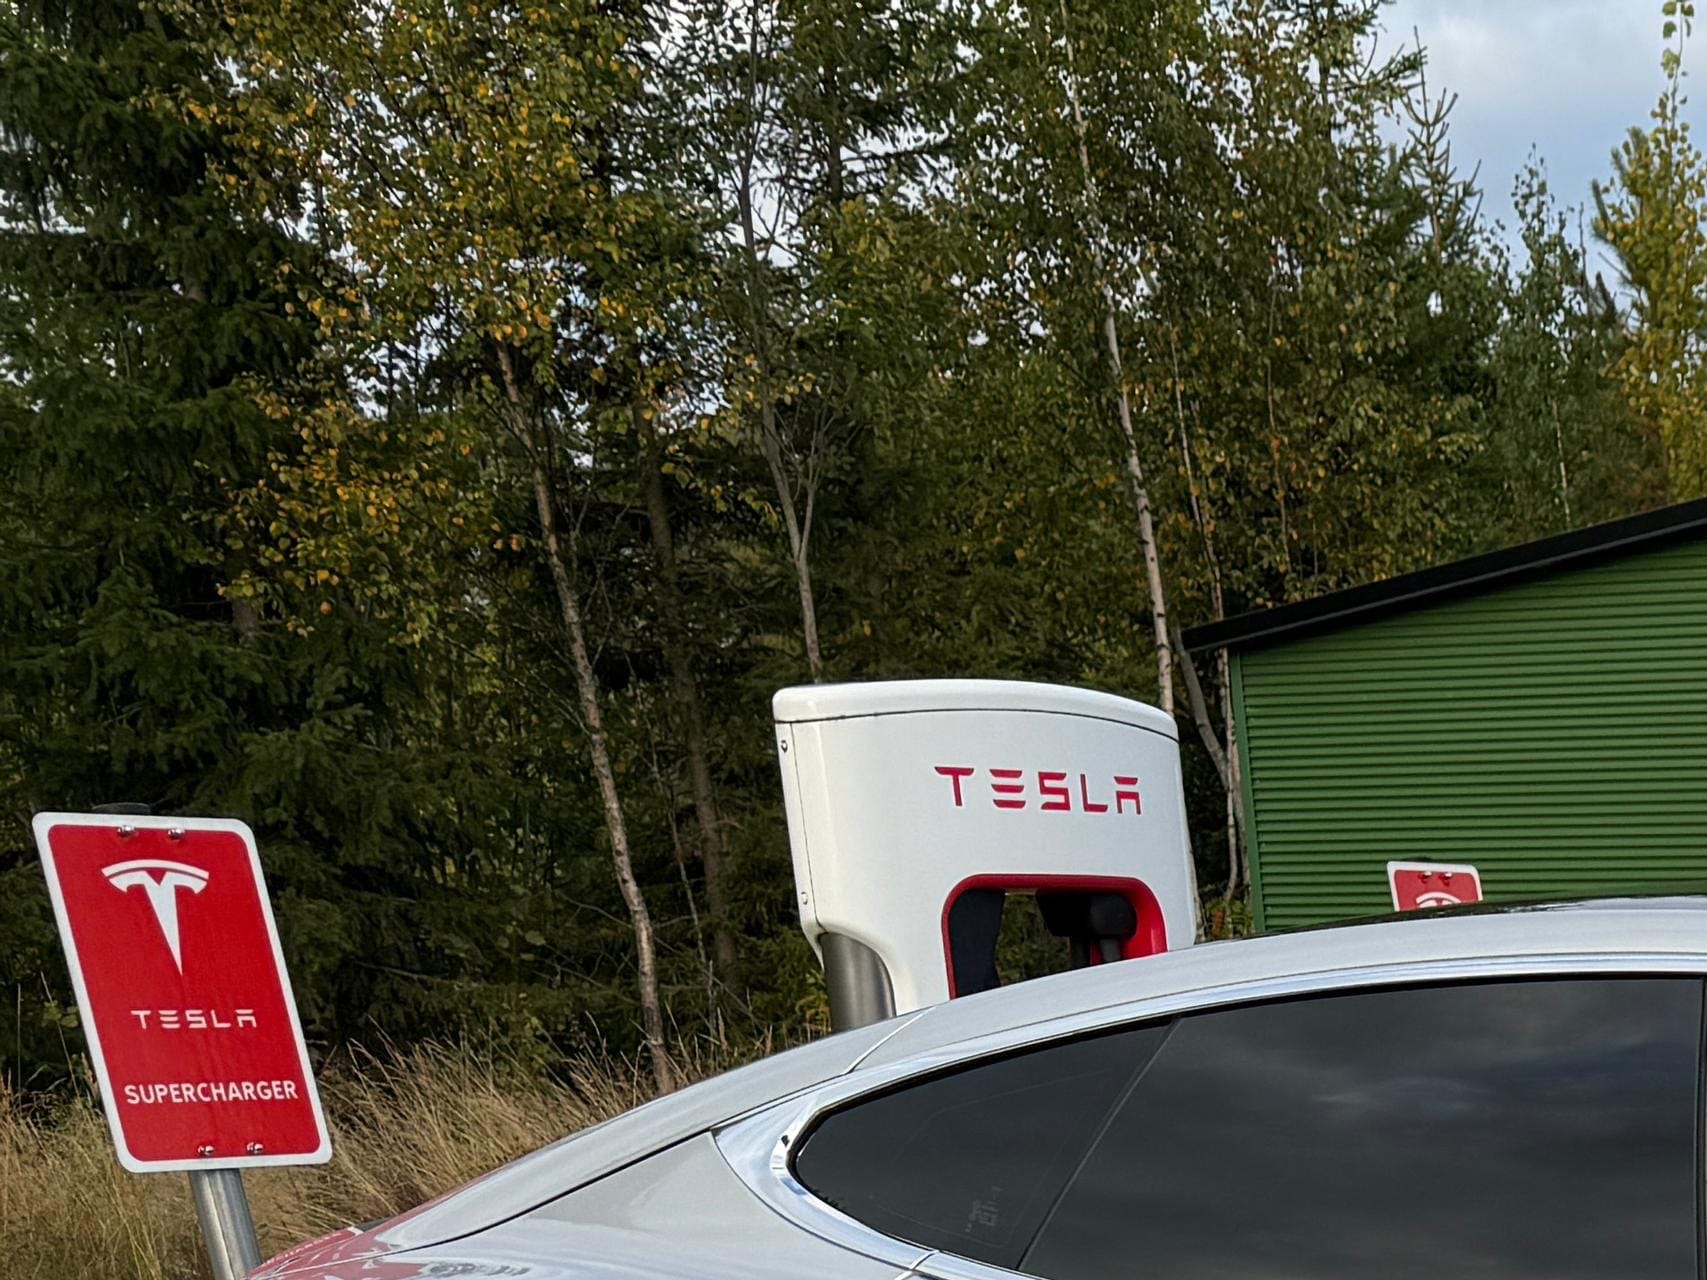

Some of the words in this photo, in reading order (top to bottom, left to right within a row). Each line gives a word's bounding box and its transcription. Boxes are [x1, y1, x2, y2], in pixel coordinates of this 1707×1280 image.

[934, 765, 1142, 815] TESLA
[131, 1009, 257, 1030] TESLA
[124, 1080, 298, 1104] SUPERCHARGER
